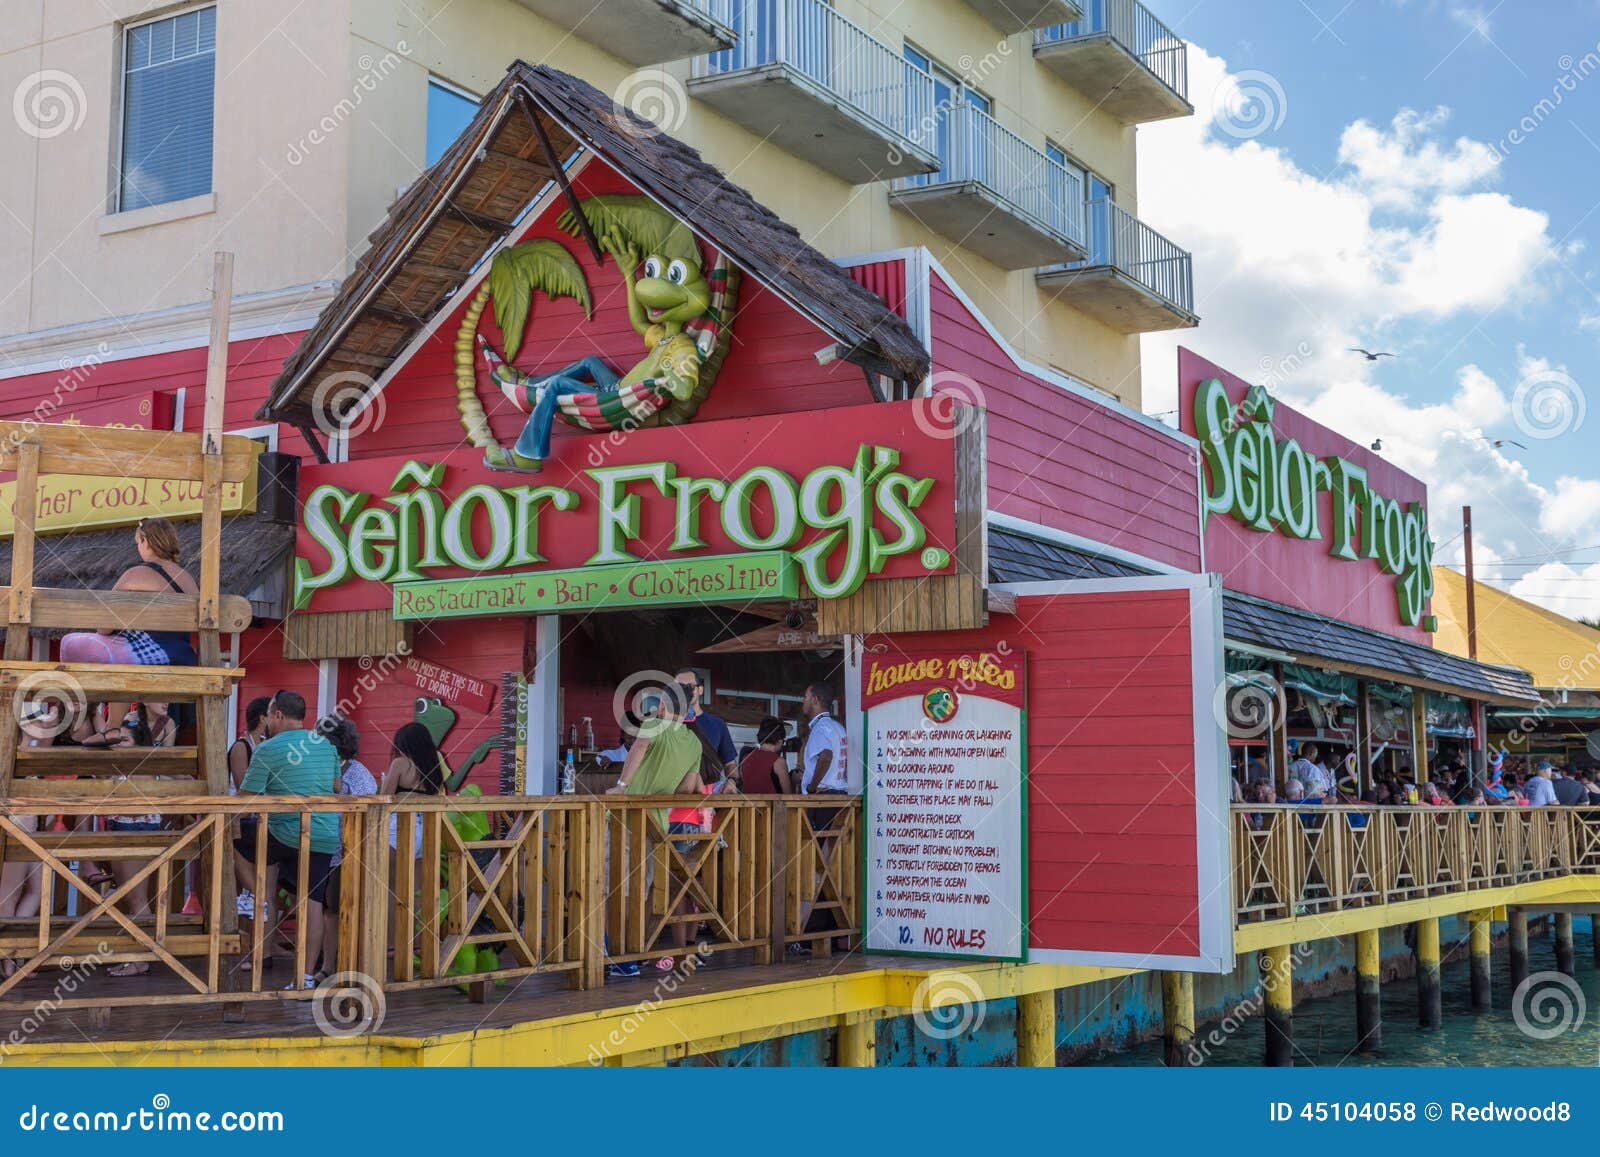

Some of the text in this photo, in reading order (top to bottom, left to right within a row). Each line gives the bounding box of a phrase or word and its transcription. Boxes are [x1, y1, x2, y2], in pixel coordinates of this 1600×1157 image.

[1194, 379, 1332, 540] Señor
[91, 477, 149, 508] cool
[295, 460, 580, 610] Señor
[583, 443, 936, 599] Frog's
[398, 564, 778, 616] Restaurant Bar Clothesline
[866, 652, 1016, 695] house rules
[416, 673, 427, 688] TO
[439, 669, 451, 684] BE
[467, 679, 484, 697] TALL
[886, 730, 897, 740] NO
[929, 730, 963, 740] GRINNING
[965, 730, 976, 741] OR
[976, 730, 1012, 740] LAUGHING
[928, 747, 943, 758] WITH
[944, 747, 966, 758] MOUTH
[966, 747, 986, 758] OPEN
[886, 763, 897, 773] NO
[897, 763, 926, 774] LOOKING
[927, 763, 955, 774] AROUND
[886, 778, 897, 789] NO
[897, 779, 914, 789] FOOT
[914, 779, 944, 790] TAPPING
[954, 779, 965, 790] WE
[965, 779, 977, 790] DO
[985, 779, 999, 790] ALL
[886, 794, 919, 806] TOGETHER
[919, 794, 933, 806] THIS
[933, 795, 956, 806] PLACE
[958, 795, 972, 806] MAY
[886, 813, 897, 823] NO
[898, 813, 925, 824] JUMPING
[925, 813, 944, 825] FROM
[944, 814, 962, 825] DECK
[886, 827, 897, 838] NO
[897, 828, 944, 839] CONSTRUCTIVE
[945, 829, 975, 840] CRITICISM
[922, 844, 952, 856] BITCHING
[952, 845, 964, 856] NO
[898, 859, 926, 871] STRICTLY
[926, 860, 963, 872] FORBIDDEN
[963, 861, 974, 873] TO
[974, 862, 1001, 873] REMOVE
[886, 875, 967, 888] SHARKS FROM THE OCEAN
[886, 890, 897, 901] NO
[897, 890, 931, 904] WHATEVER
[931, 892, 945, 904] YOU
[945, 892, 963, 904] HAVE
[973, 894, 990, 905] MIND
[885, 907, 897, 918] NO
[897, 907, 927, 919] NOTHING
[898, 925, 986, 950] 10. NO RULES
